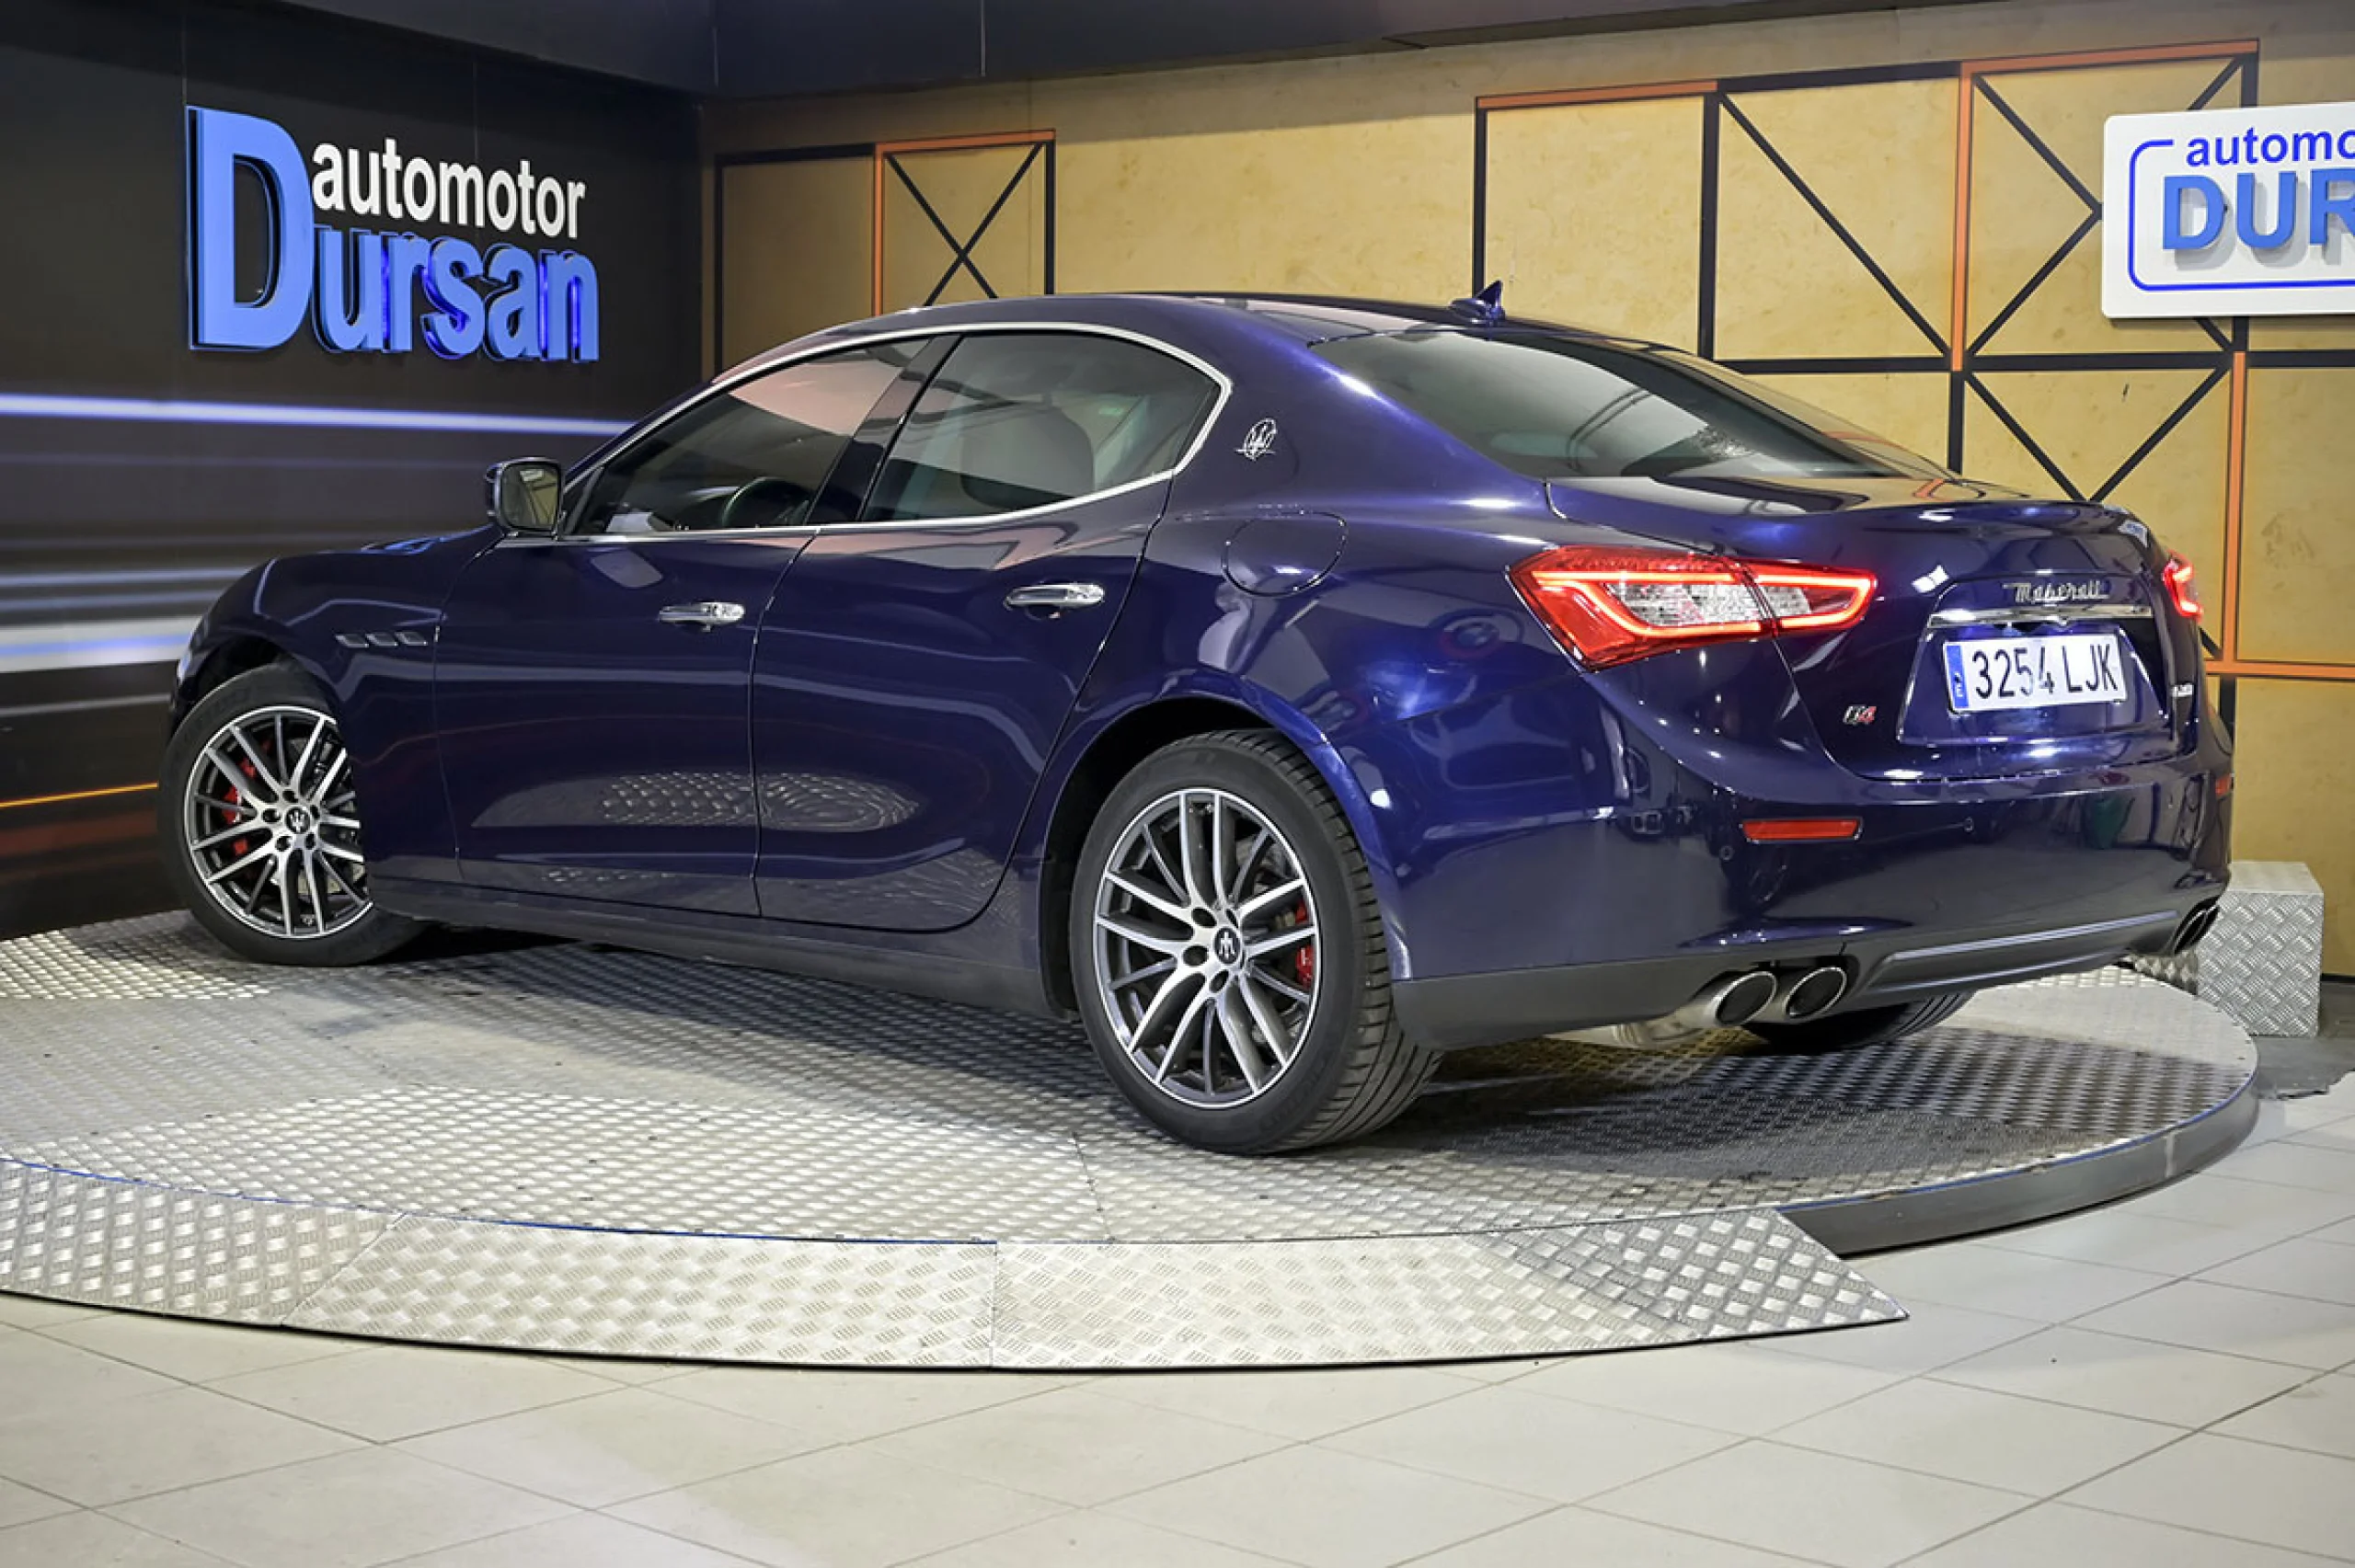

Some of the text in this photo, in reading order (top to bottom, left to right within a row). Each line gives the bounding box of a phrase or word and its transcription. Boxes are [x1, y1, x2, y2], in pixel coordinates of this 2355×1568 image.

[312, 138, 585, 238] automotor
[2186, 127, 2355, 167] automo
[186, 105, 599, 363] Dursan
[2162, 167, 2355, 250] DUR
[1971, 643, 2119, 699] 3254 LJK
